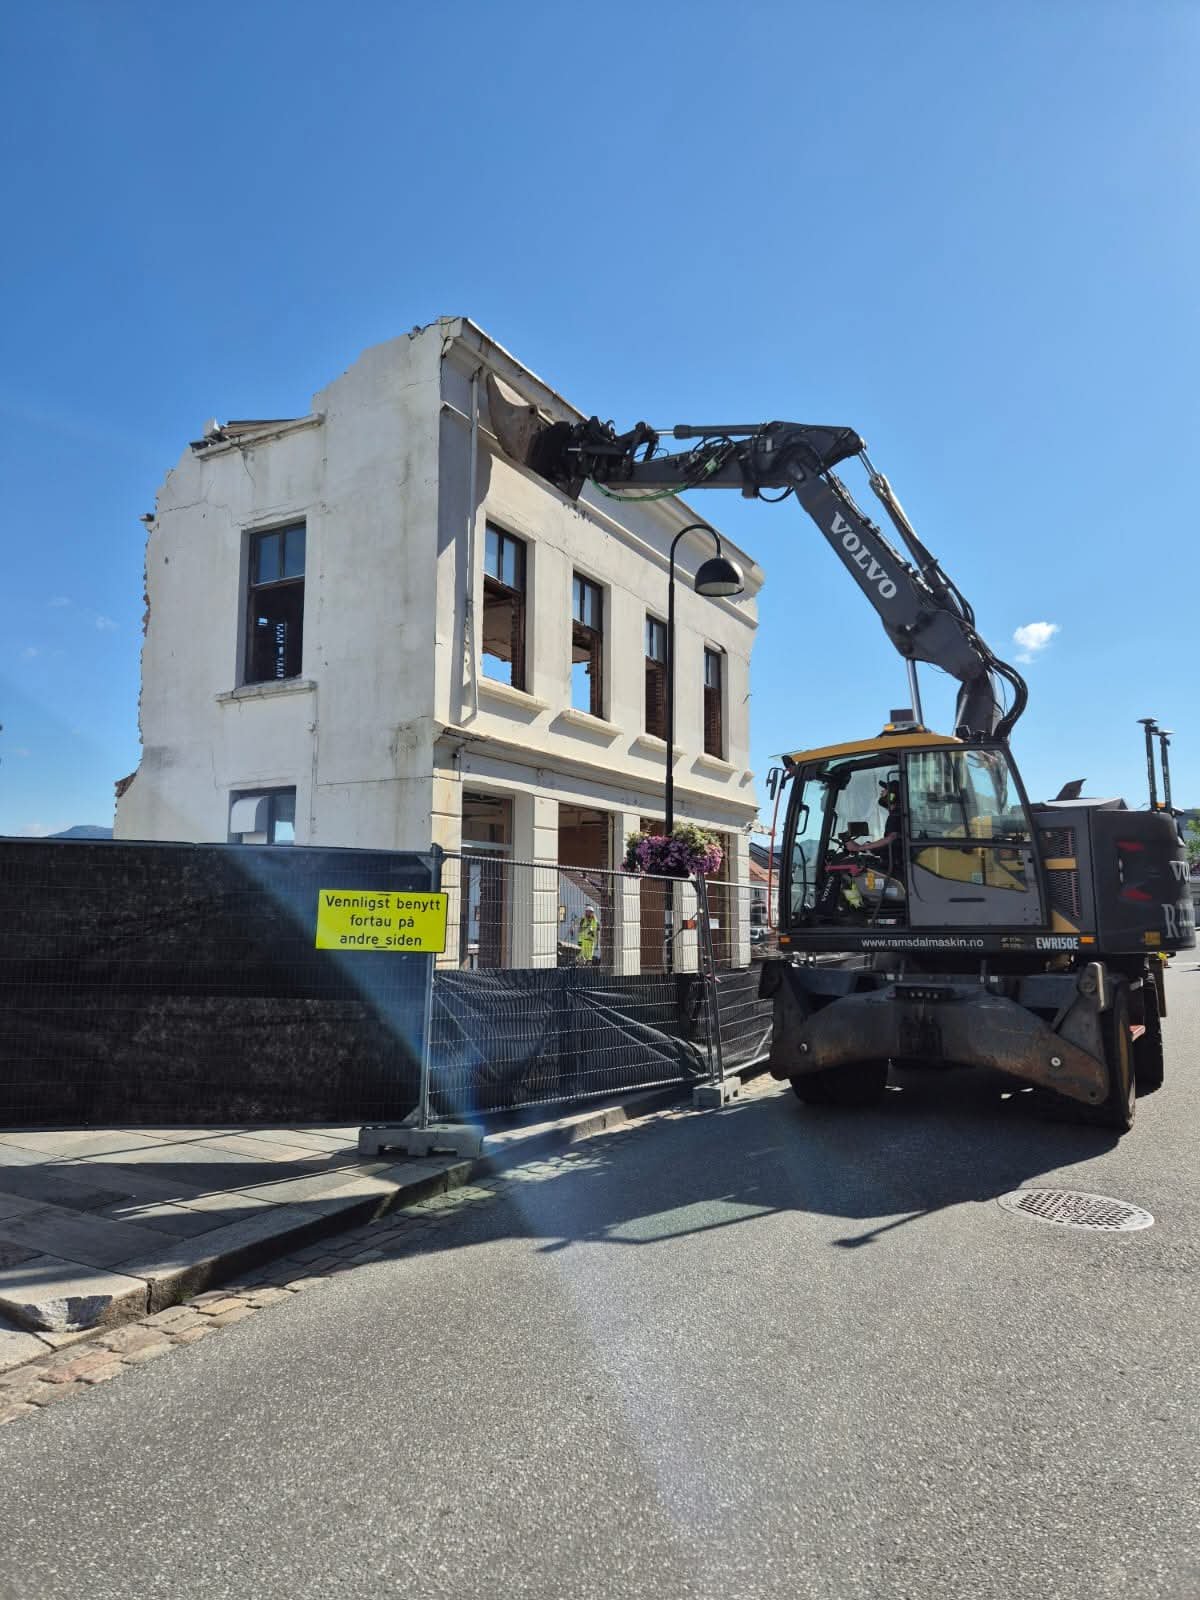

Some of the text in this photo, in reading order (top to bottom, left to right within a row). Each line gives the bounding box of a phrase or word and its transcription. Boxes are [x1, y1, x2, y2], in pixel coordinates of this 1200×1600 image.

[830, 511, 897, 599] VOLVO
[326, 895, 441, 912] Vennligst benytt
[350, 914, 415, 930] fortau på
[340, 933, 422, 946] andre siden
[861, 938, 984, 948] www.ramsdalmaskin.no
[1035, 936, 1079, 950] EWR150E
